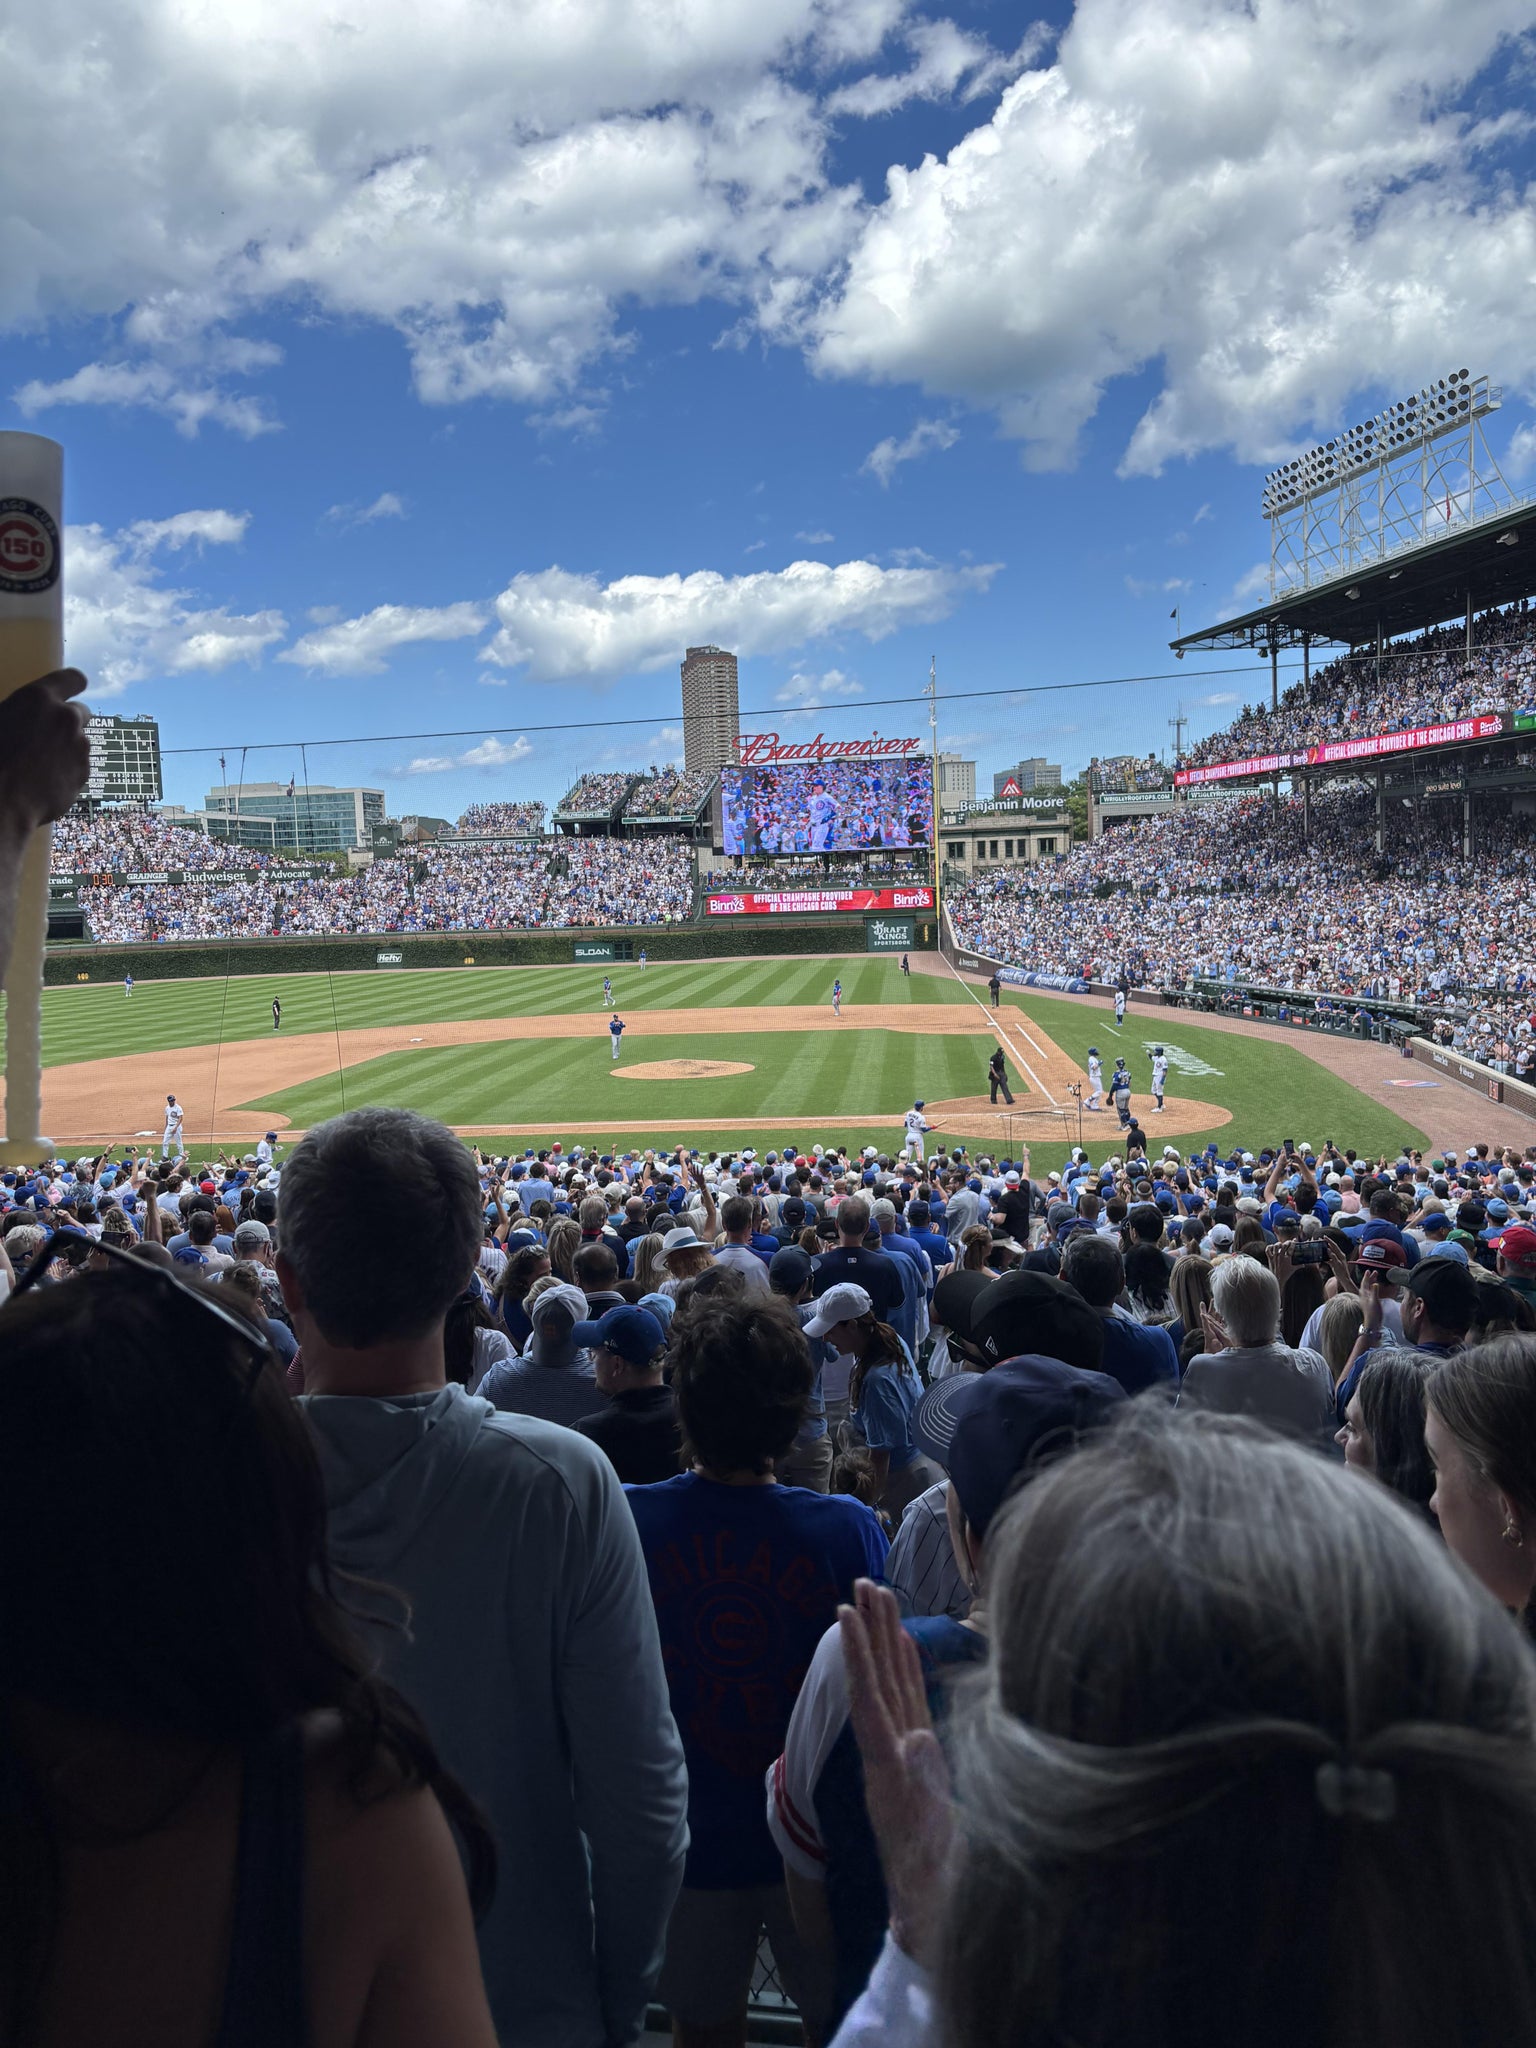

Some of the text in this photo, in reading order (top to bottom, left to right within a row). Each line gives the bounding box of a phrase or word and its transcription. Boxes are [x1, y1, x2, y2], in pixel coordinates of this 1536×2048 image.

[3, 537, 45, 558] 150
[1324, 722, 1474, 760] OFFICIAL CHAMPAGNE PROVIDER OF THE CHICAGO CUBS
[732, 731, 921, 765] Budweiser
[960, 797, 1063, 814] Benjamin Moore
[126, 872, 169, 880] GRAINGER
[270, 870, 311, 879] Advocate
[753, 890, 853, 903] OFFICIAL CHAMPAGNE PROVIDER
[769, 900, 837, 912] OF THE CHICAGO CUBS
[873, 925, 909, 935] DRAFT
[379, 954, 401, 962] Hefty
[909, 1118, 915, 1128] 2
